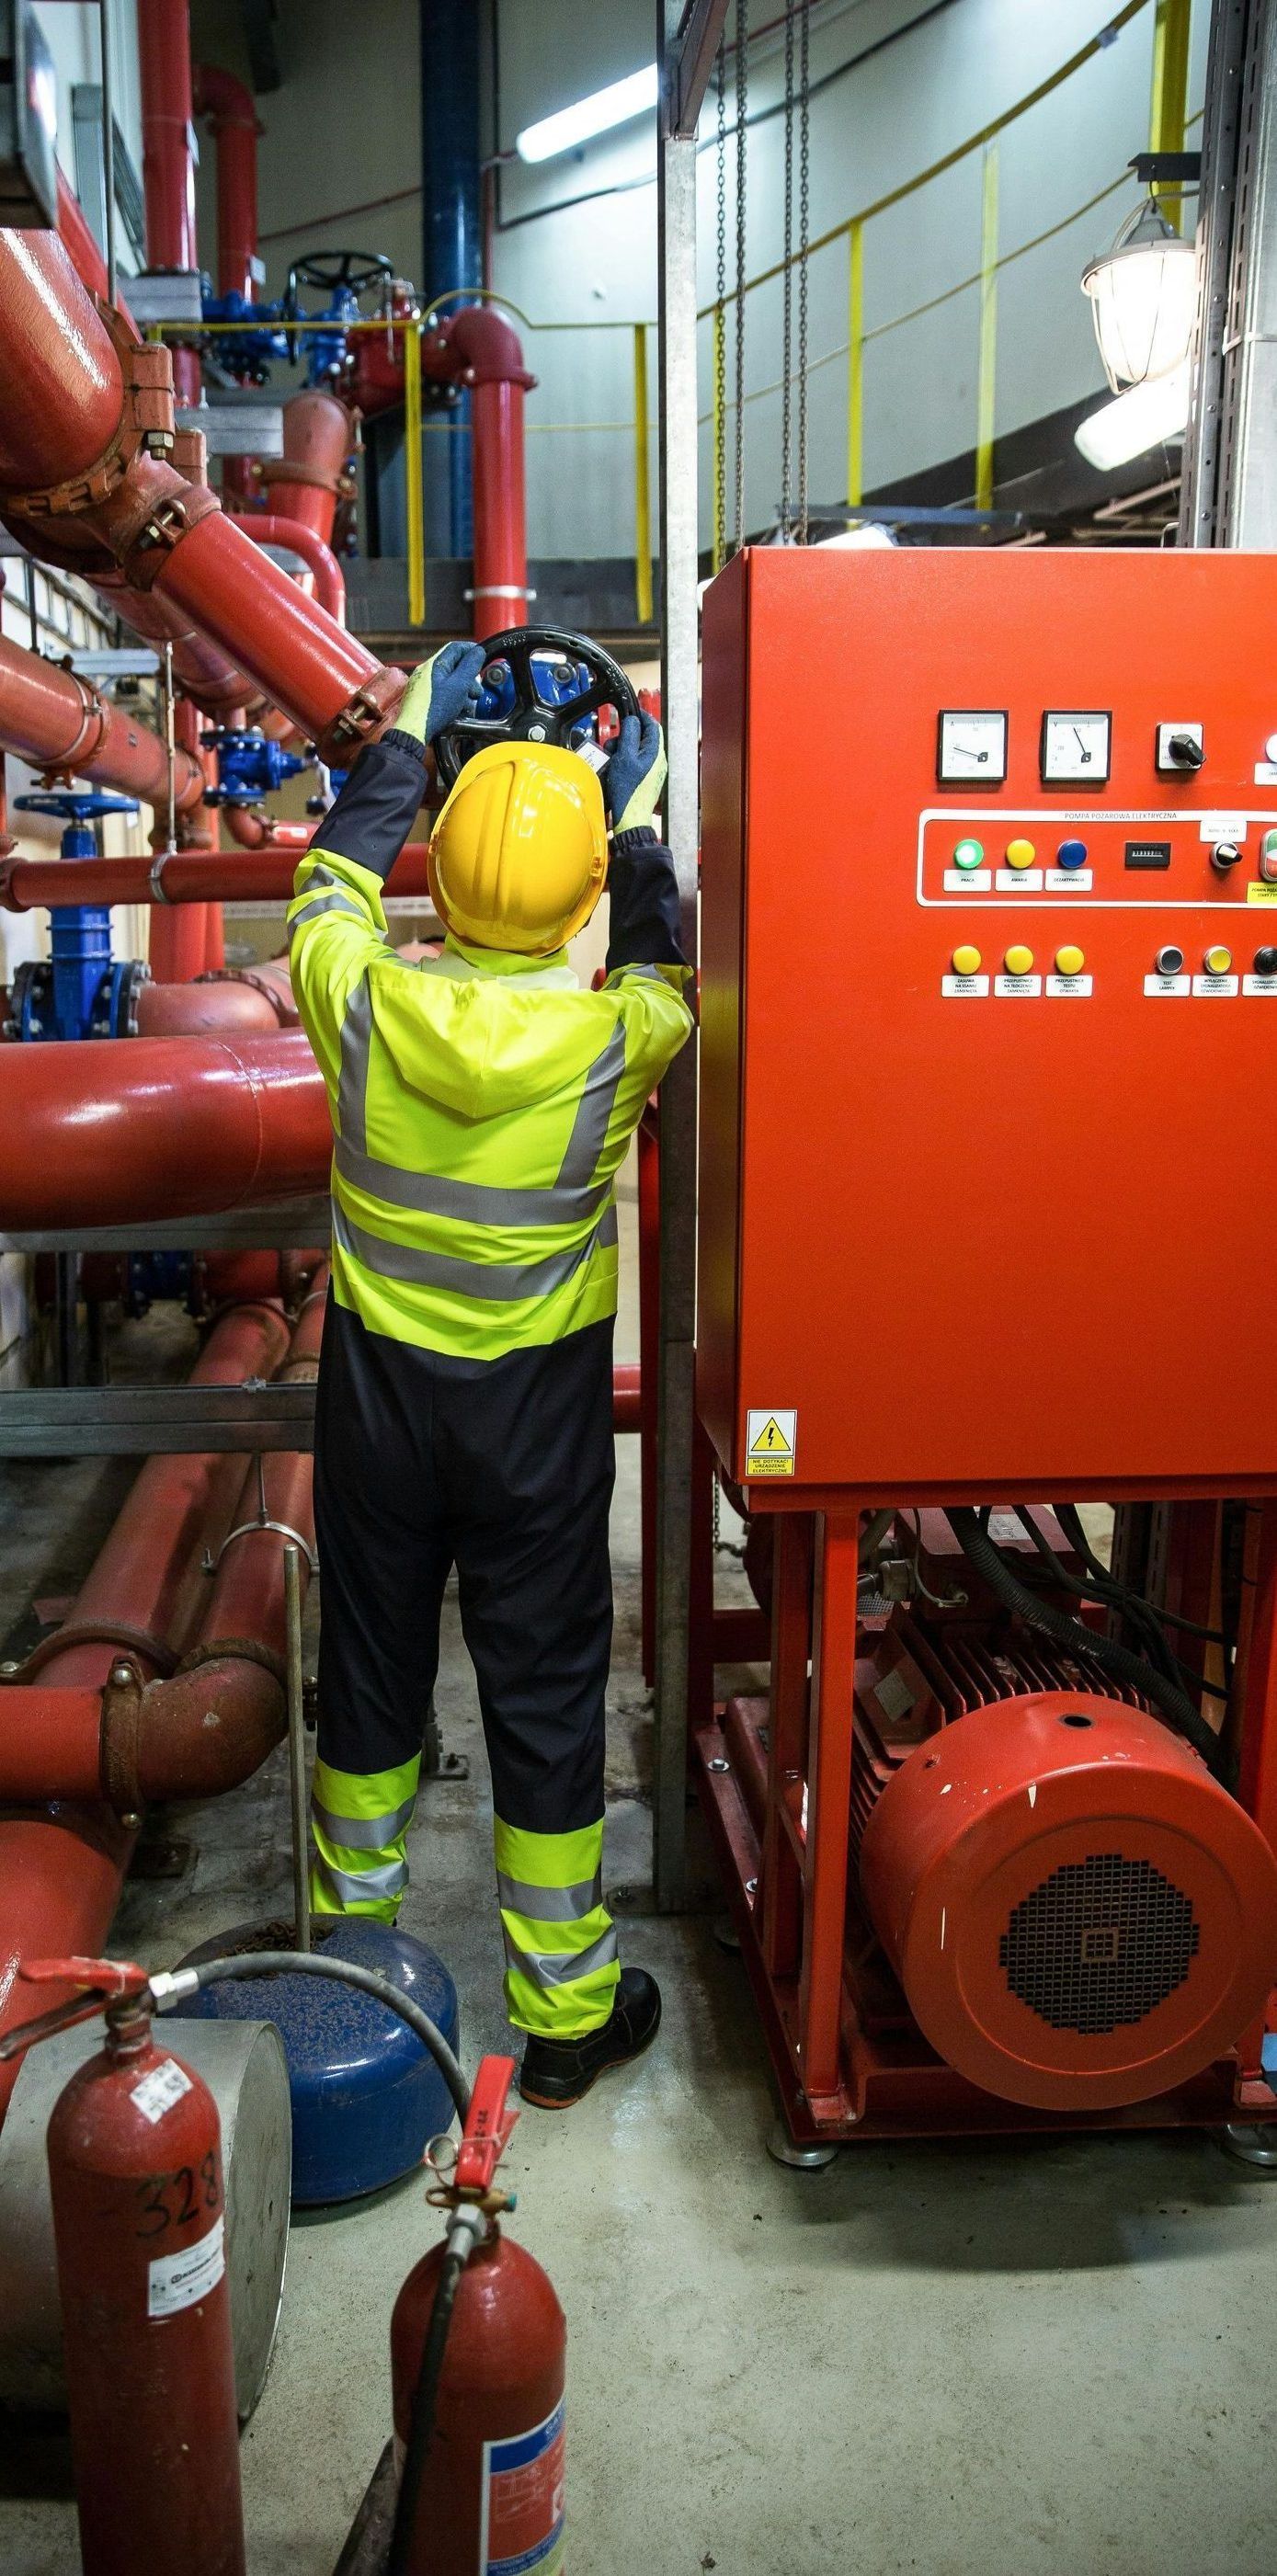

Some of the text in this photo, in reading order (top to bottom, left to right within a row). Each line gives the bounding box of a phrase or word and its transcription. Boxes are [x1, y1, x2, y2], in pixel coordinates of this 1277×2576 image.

[1065, 812, 1089, 820] POMPA
[1132, 812, 1178, 820] ELEKTRYCZNA
[135, 2149, 221, 2239] 328
